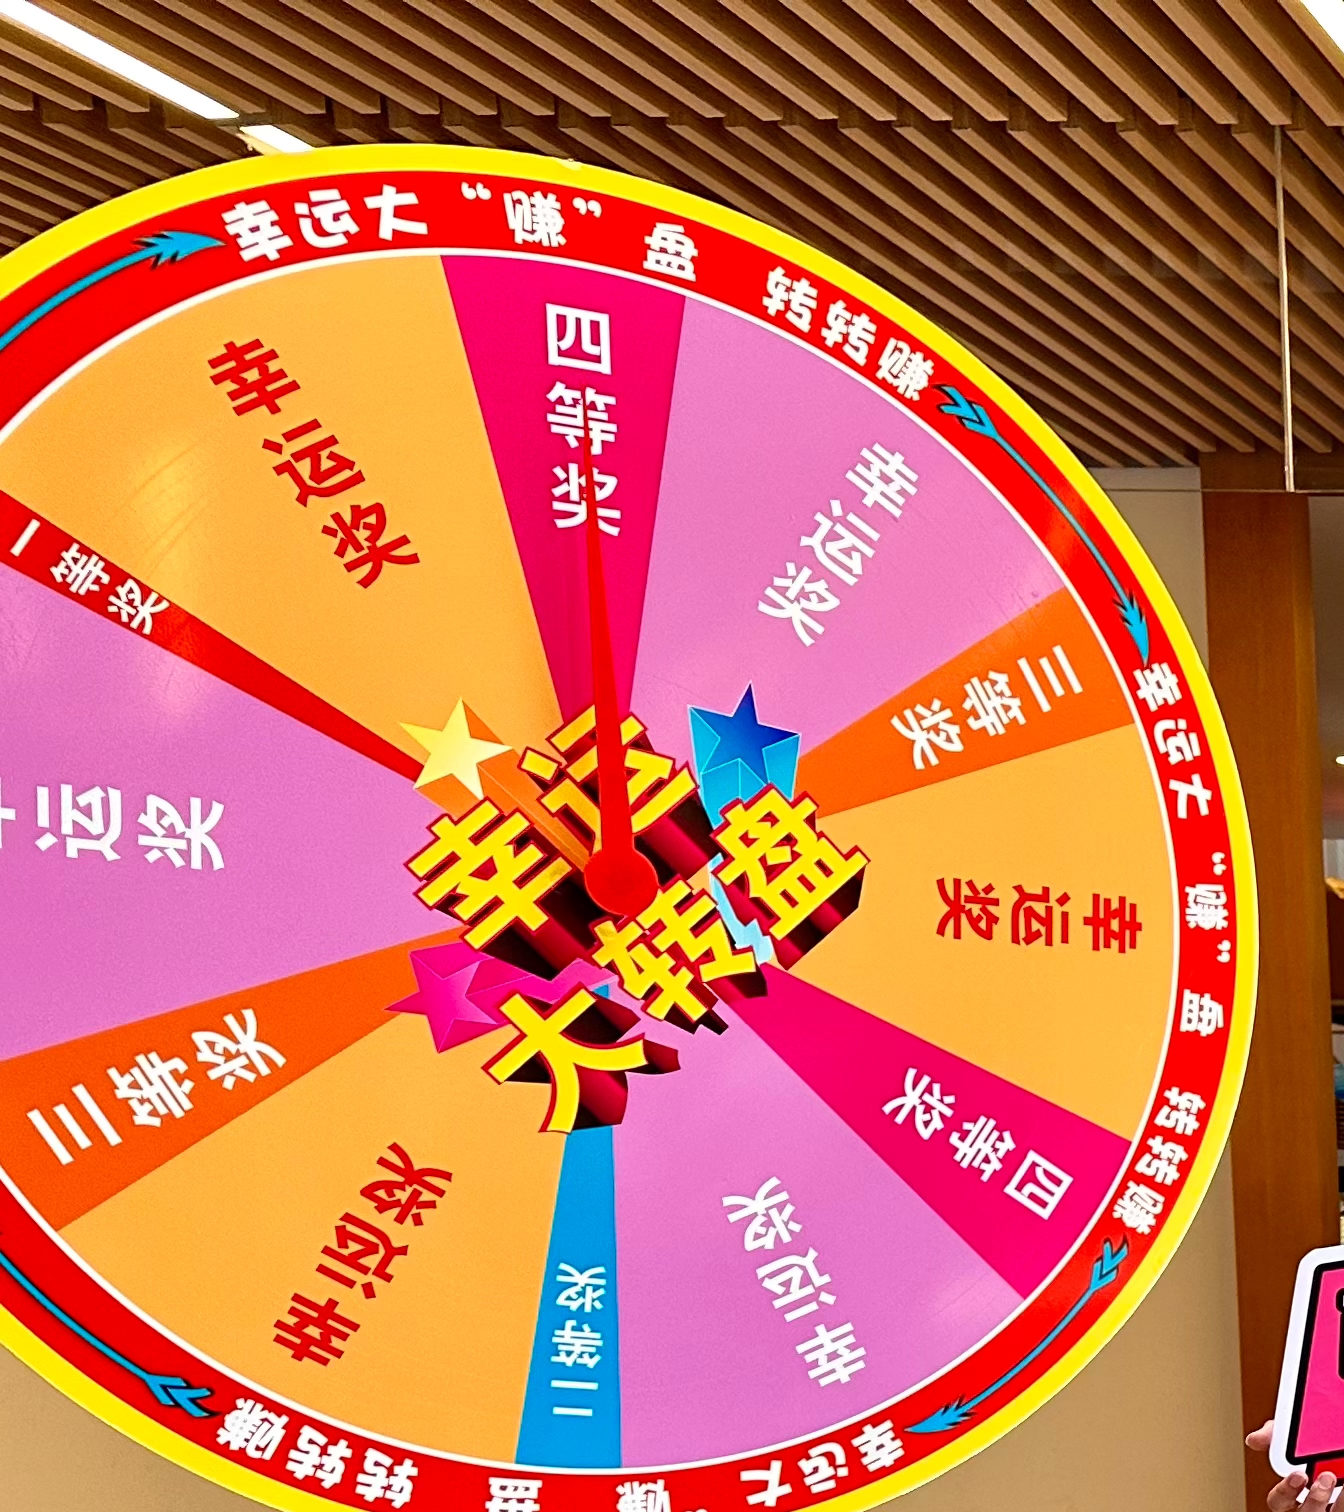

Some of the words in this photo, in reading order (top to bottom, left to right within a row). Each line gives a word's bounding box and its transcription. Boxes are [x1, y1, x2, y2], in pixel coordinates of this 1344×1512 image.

[762, 266, 935, 401] 转转赚
[207, 338, 420, 588] 幸运奖
[545, 302, 621, 536] 四等奖
[9, 518, 171, 635] 一等奖
[757, 442, 919, 647] 幸运奖
[890, 644, 1083, 770] 三等奖
[0, 782, 225, 872] 运奖
[935, 877, 1142, 954] 幸运奖
[27, 1008, 287, 1165] 三等奖
[881, 1068, 1073, 1221] 四等奖
[1112, 1085, 1201, 1237] 转转赚
[272, 1141, 454, 1368] 幸运奖
[721, 1176, 868, 1388] 幸运奖
[551, 1261, 607, 1417] 二等奖
[215, 1398, 419, 1509] 转转赚
